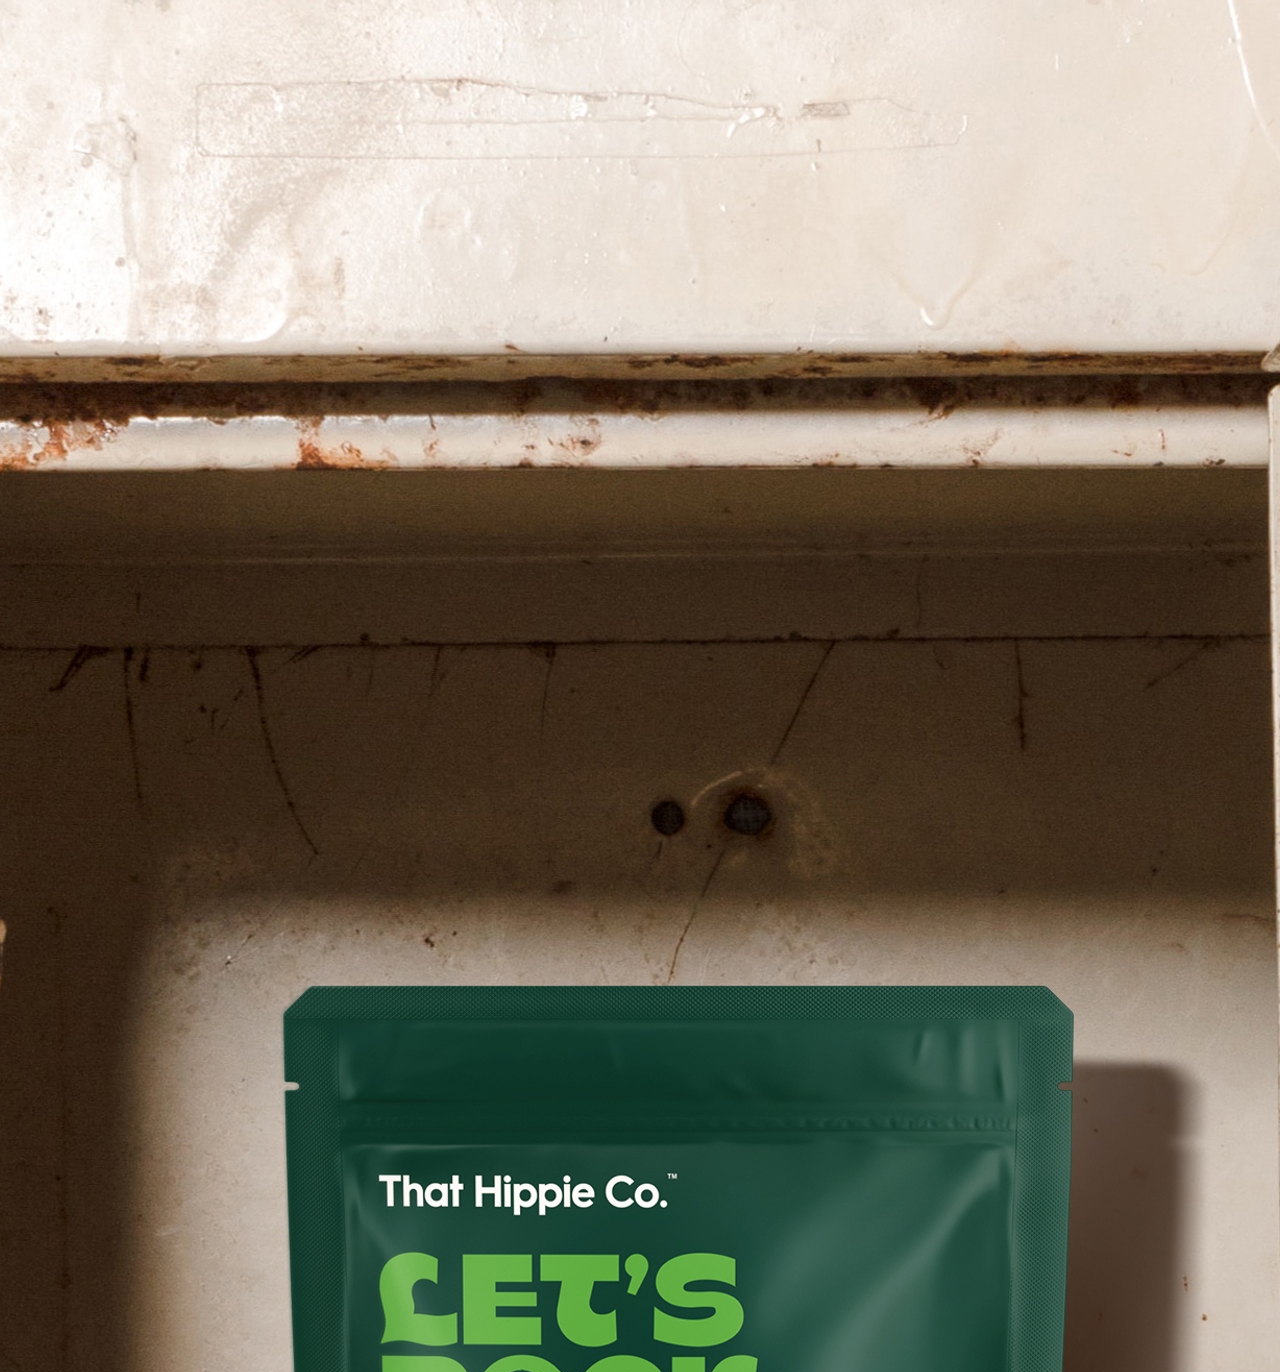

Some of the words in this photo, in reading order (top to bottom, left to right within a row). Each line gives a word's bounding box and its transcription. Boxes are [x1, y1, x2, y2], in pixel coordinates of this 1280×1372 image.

[378, 1174, 464, 1208] That
[474, 1174, 596, 1216] Hippie
[379, 1252, 744, 1348] LET'S
